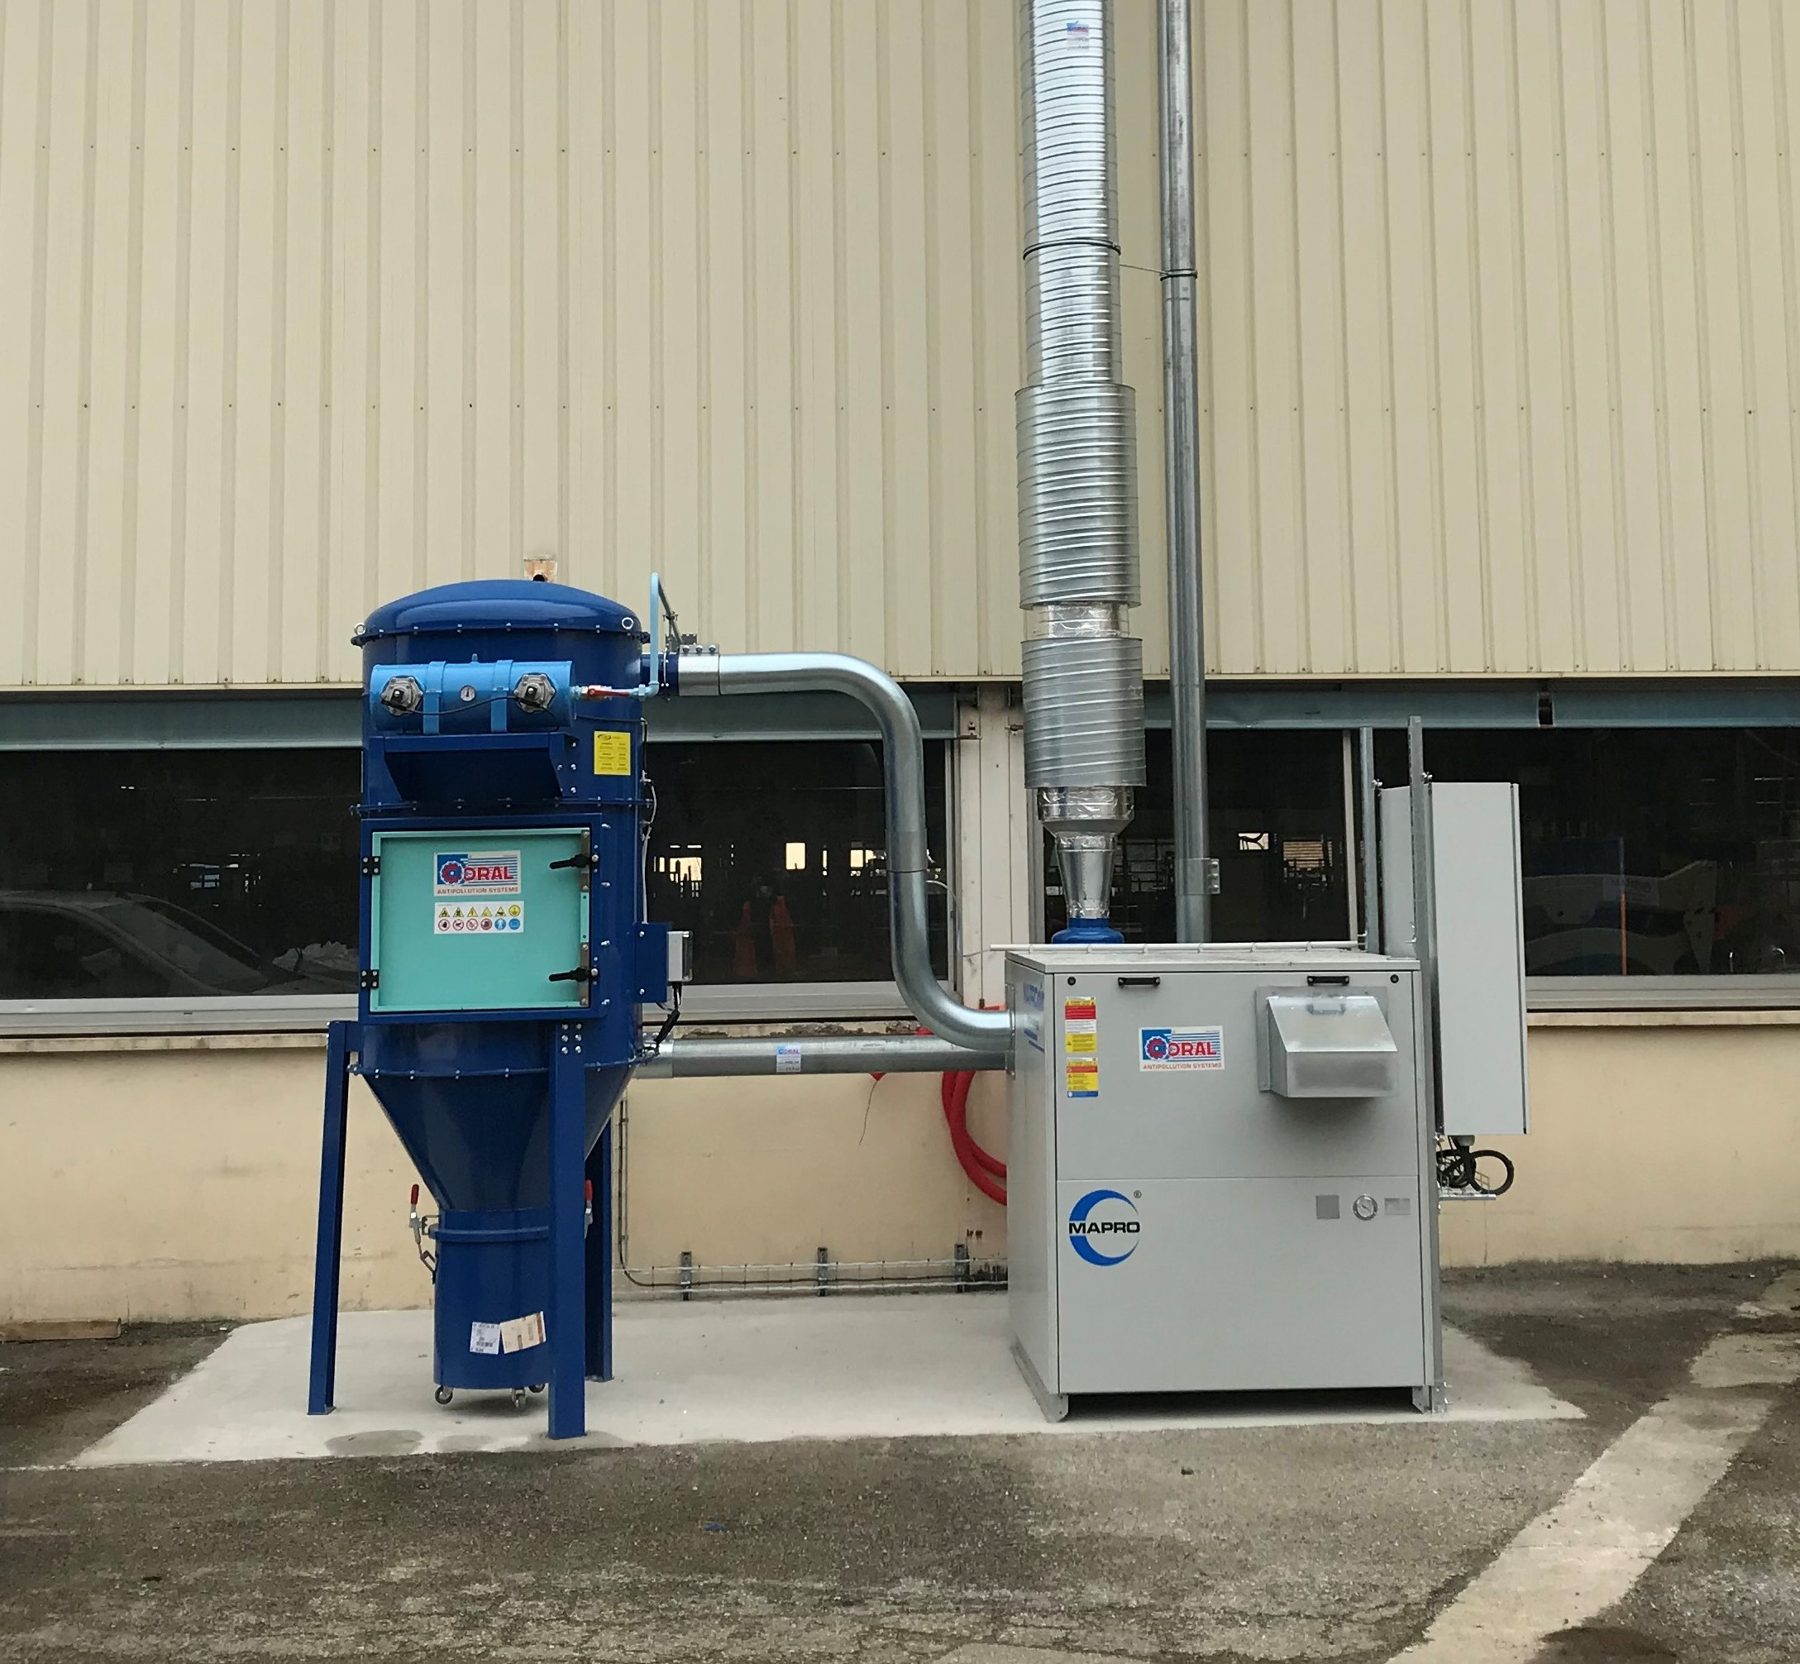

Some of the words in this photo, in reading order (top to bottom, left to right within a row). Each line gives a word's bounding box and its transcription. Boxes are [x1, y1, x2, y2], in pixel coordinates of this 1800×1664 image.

[441, 862, 514, 884] CORAL
[437, 887, 487, 895] ANTIPOLLUTION
[1146, 1037, 1217, 1059] CORAL
[1069, 1221, 1140, 1234] MAPRO
